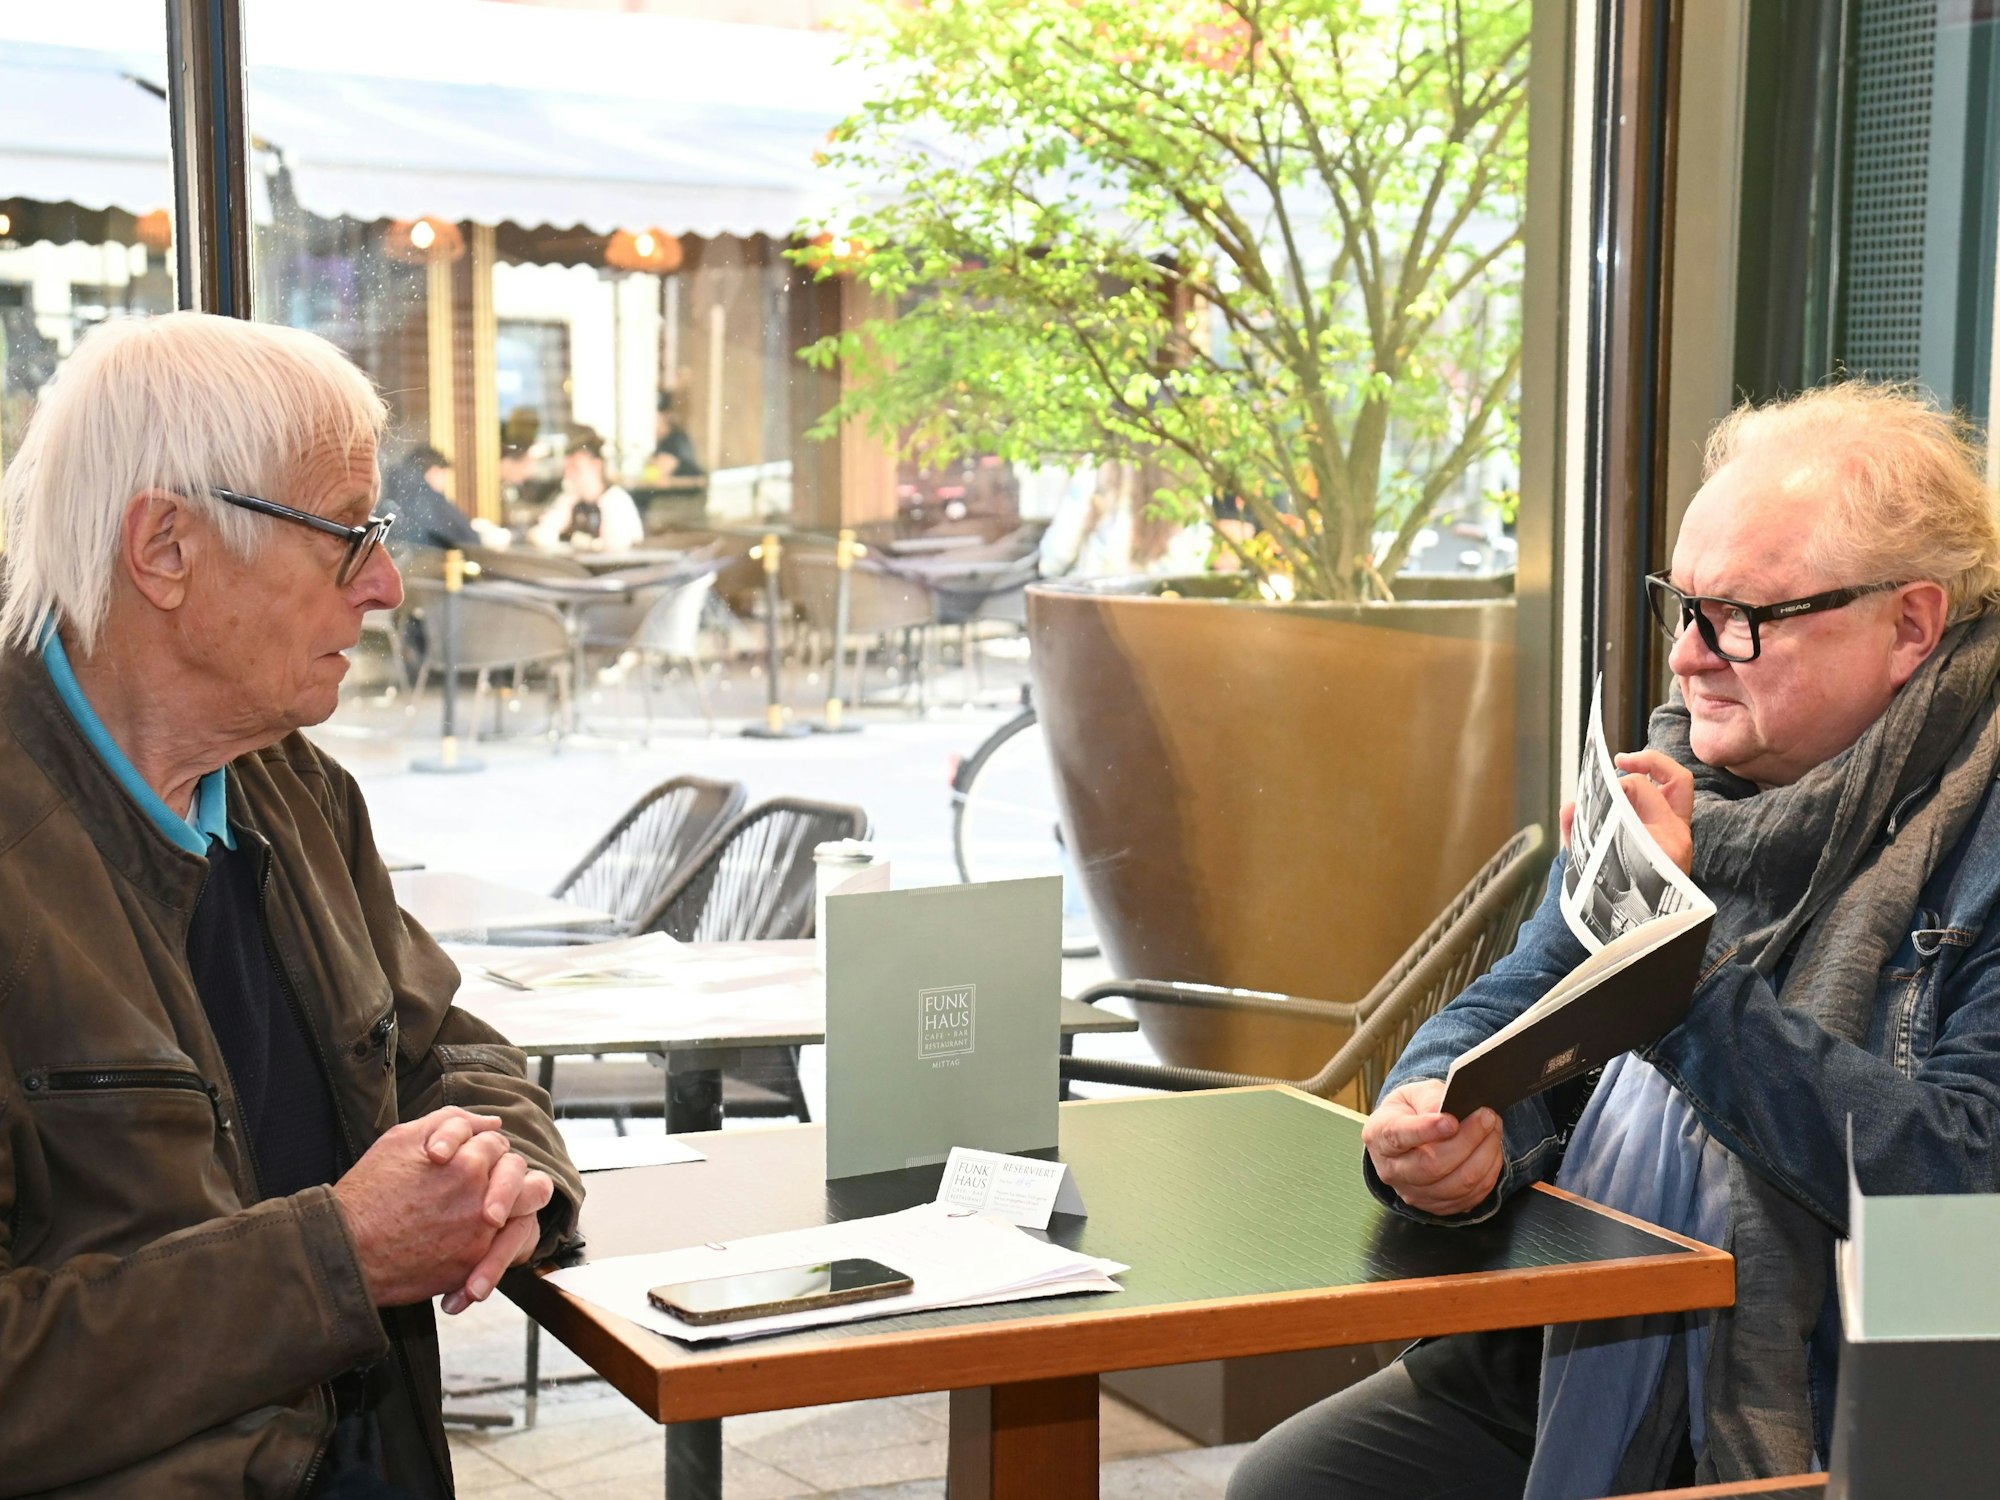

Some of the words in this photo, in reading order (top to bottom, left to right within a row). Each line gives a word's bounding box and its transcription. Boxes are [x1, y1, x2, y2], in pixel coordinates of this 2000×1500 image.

[1780, 603, 1811, 614] HEAD
[925, 992, 969, 1013] FUNK
[925, 1011, 969, 1031] HAUS
[953, 1029, 968, 1038] BAR
[924, 1039, 968, 1050] RESTAURANT
[932, 1059, 960, 1069] MITTAG
[959, 1162, 991, 1177] FUNK
[1002, 1162, 1057, 1178] RESERVIERT
[954, 1174, 987, 1189] HAUS
